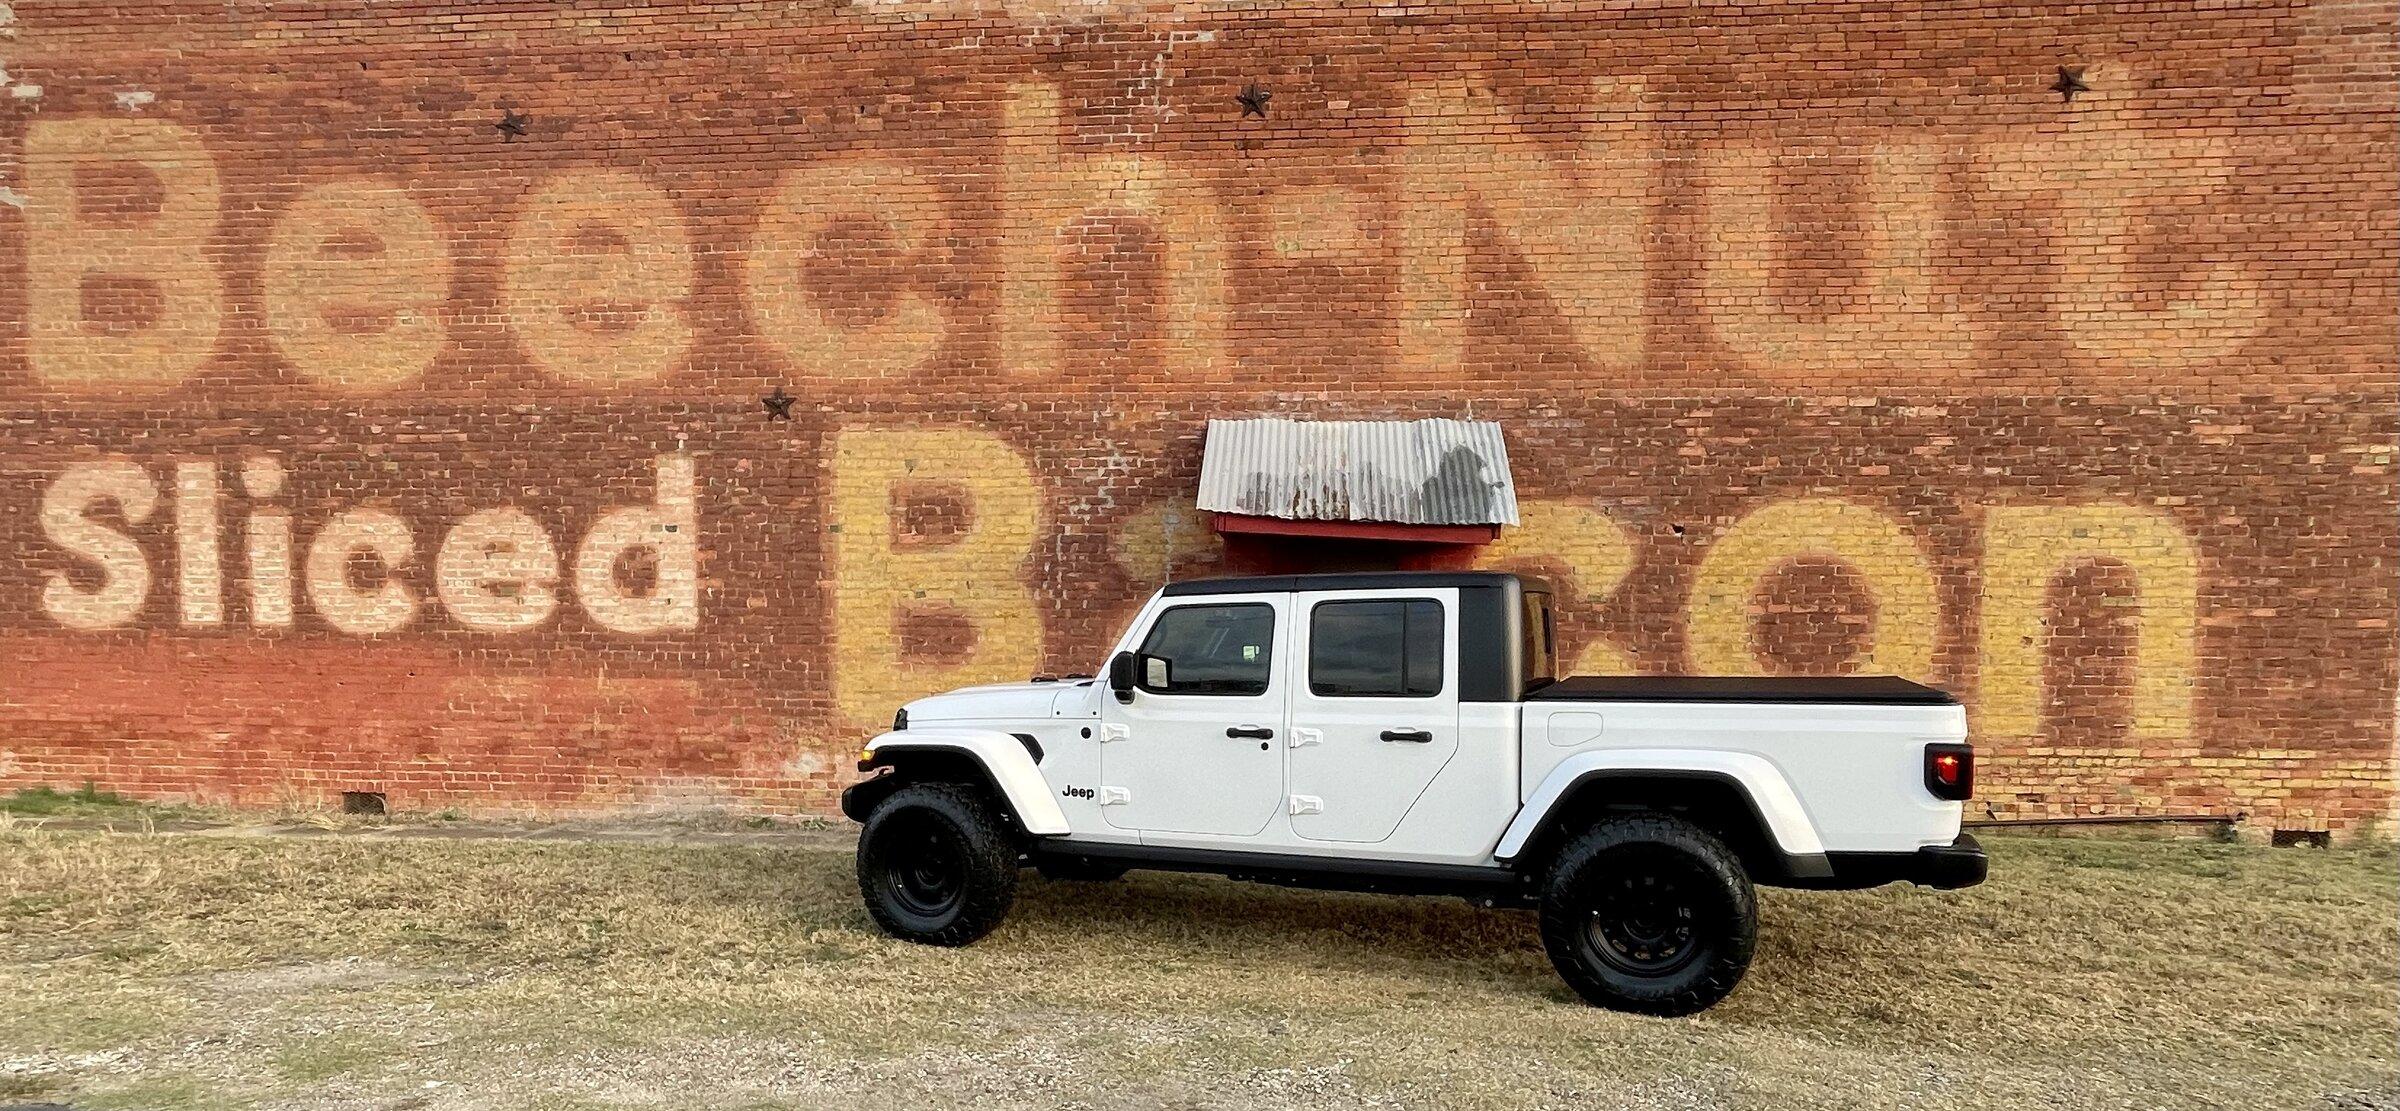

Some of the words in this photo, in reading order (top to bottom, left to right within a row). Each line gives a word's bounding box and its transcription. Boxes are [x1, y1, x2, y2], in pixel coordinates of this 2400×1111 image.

[22, 64, 2268, 386] Beech-Nut
[40, 453, 698, 634] Sliced
[834, 425, 2197, 739] Bon
[1062, 784, 1095, 800] Jeep
